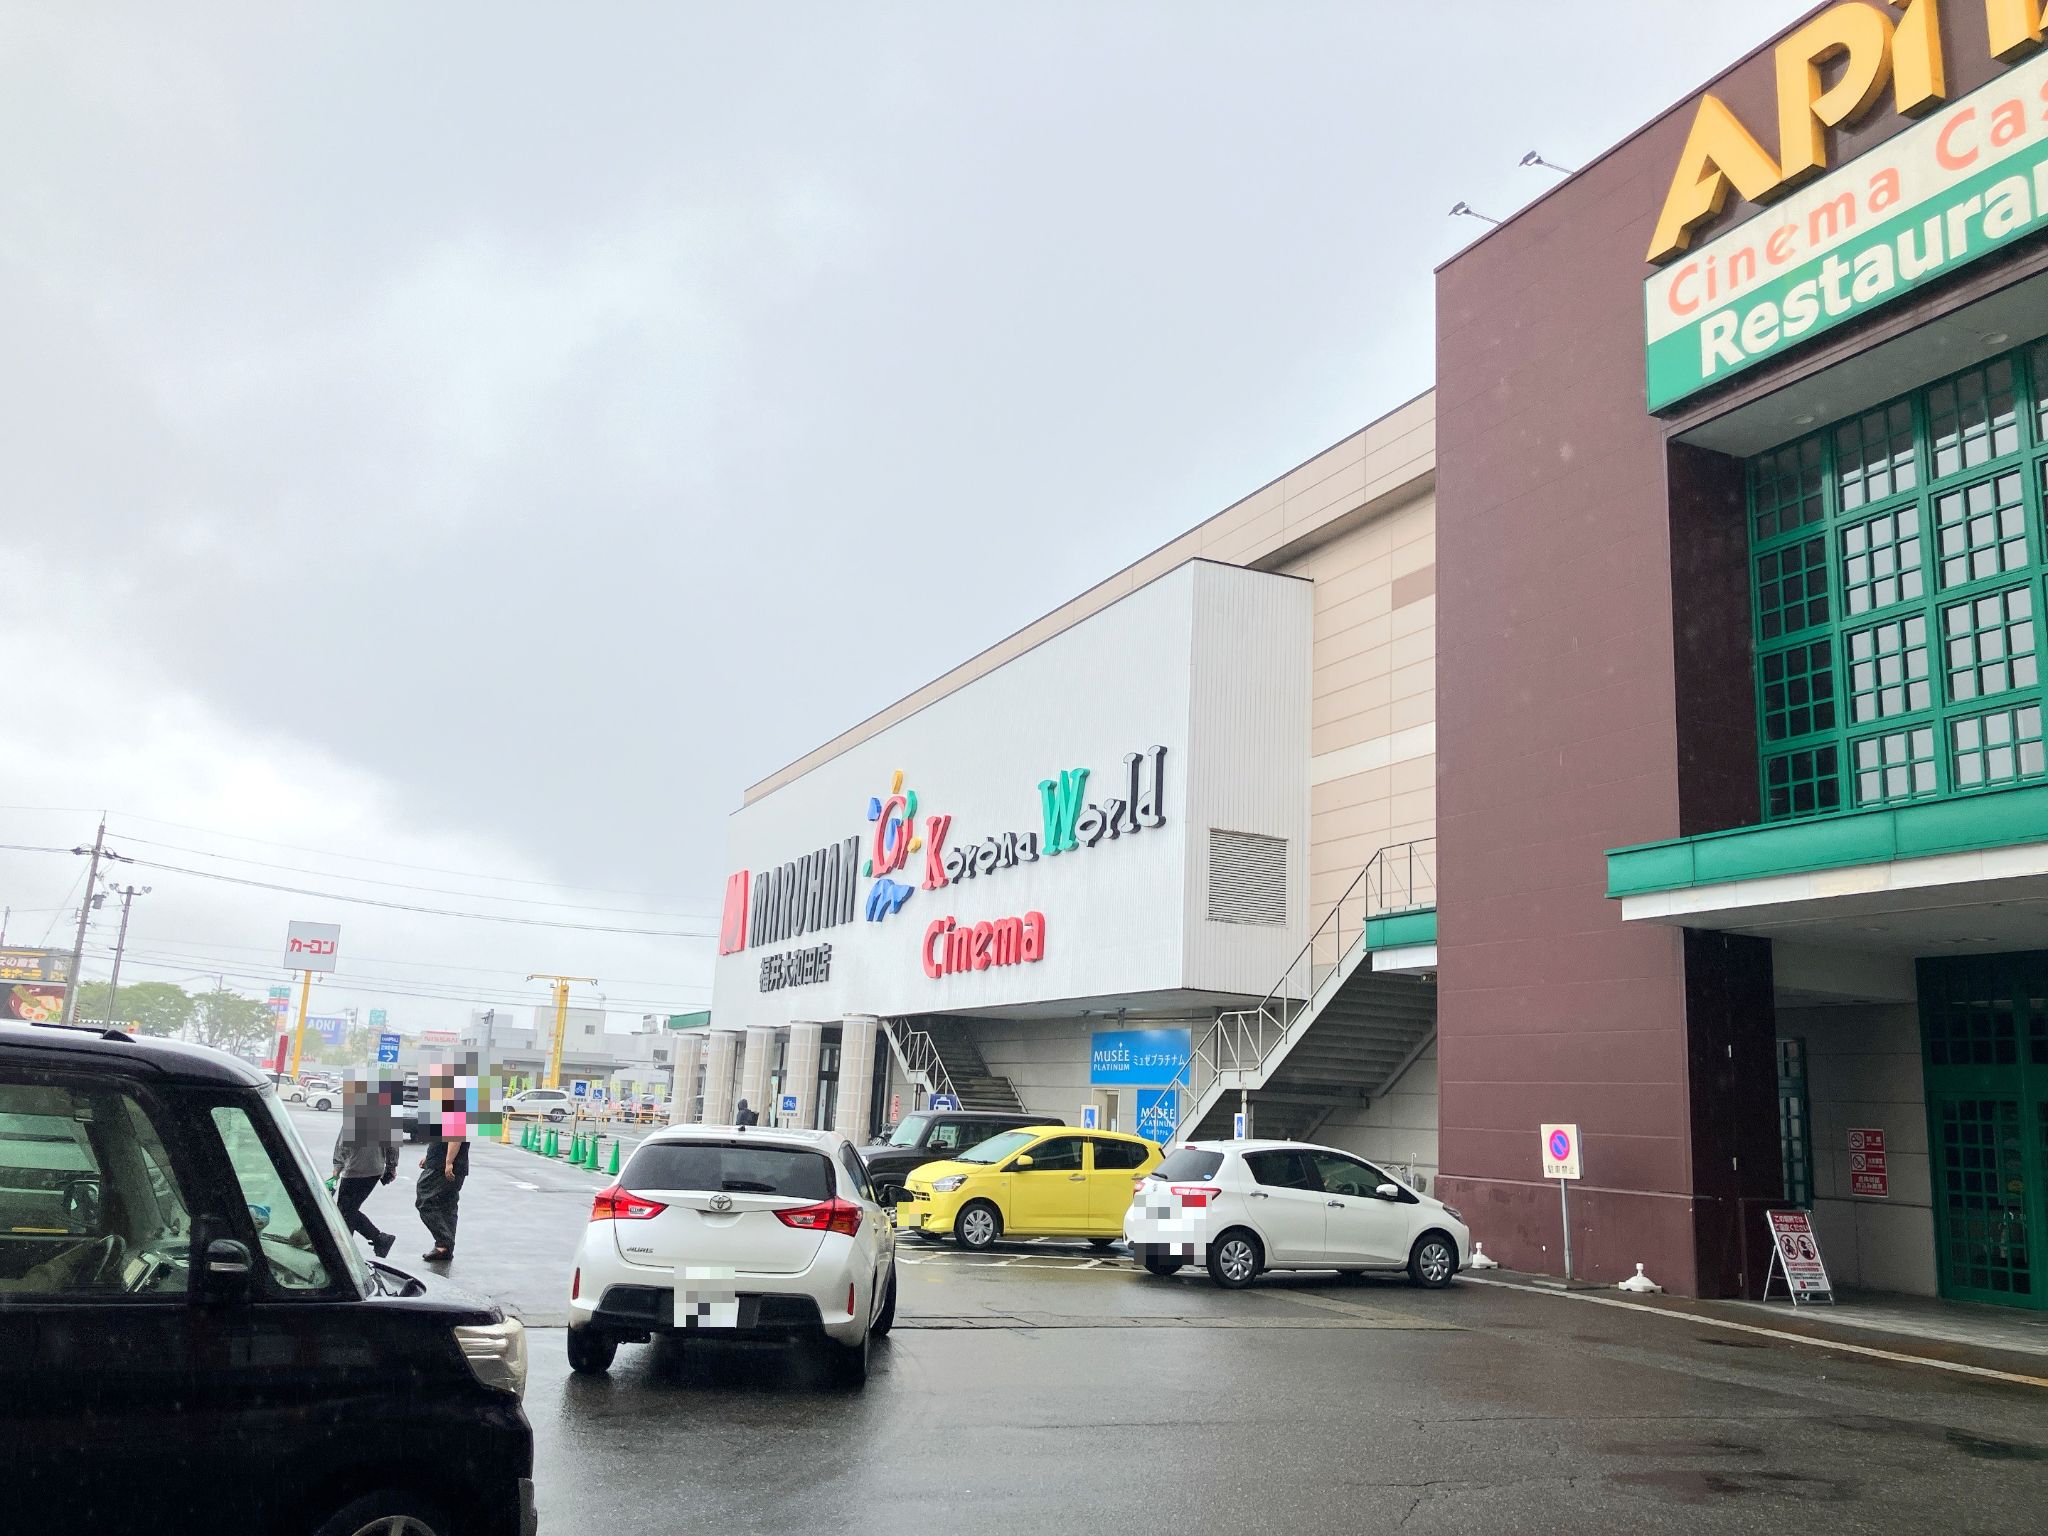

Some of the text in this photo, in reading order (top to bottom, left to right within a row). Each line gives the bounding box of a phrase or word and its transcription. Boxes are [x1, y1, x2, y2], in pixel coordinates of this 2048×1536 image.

[1668, 167, 1902, 317] Cinema
[922, 745, 1168, 890] Korona World
[749, 835, 859, 948] MARUHAN
[290, 938, 335, 955] カーコン
[760, 942, 833, 992] 福井大和田店
[922, 911, 1045, 979] Cinema
[307, 1018, 336, 1030] AOKI
[1093, 1063, 1130, 1071] PLATINUM
[1133, 1053, 1186, 1066] ミュゼプラチナム
